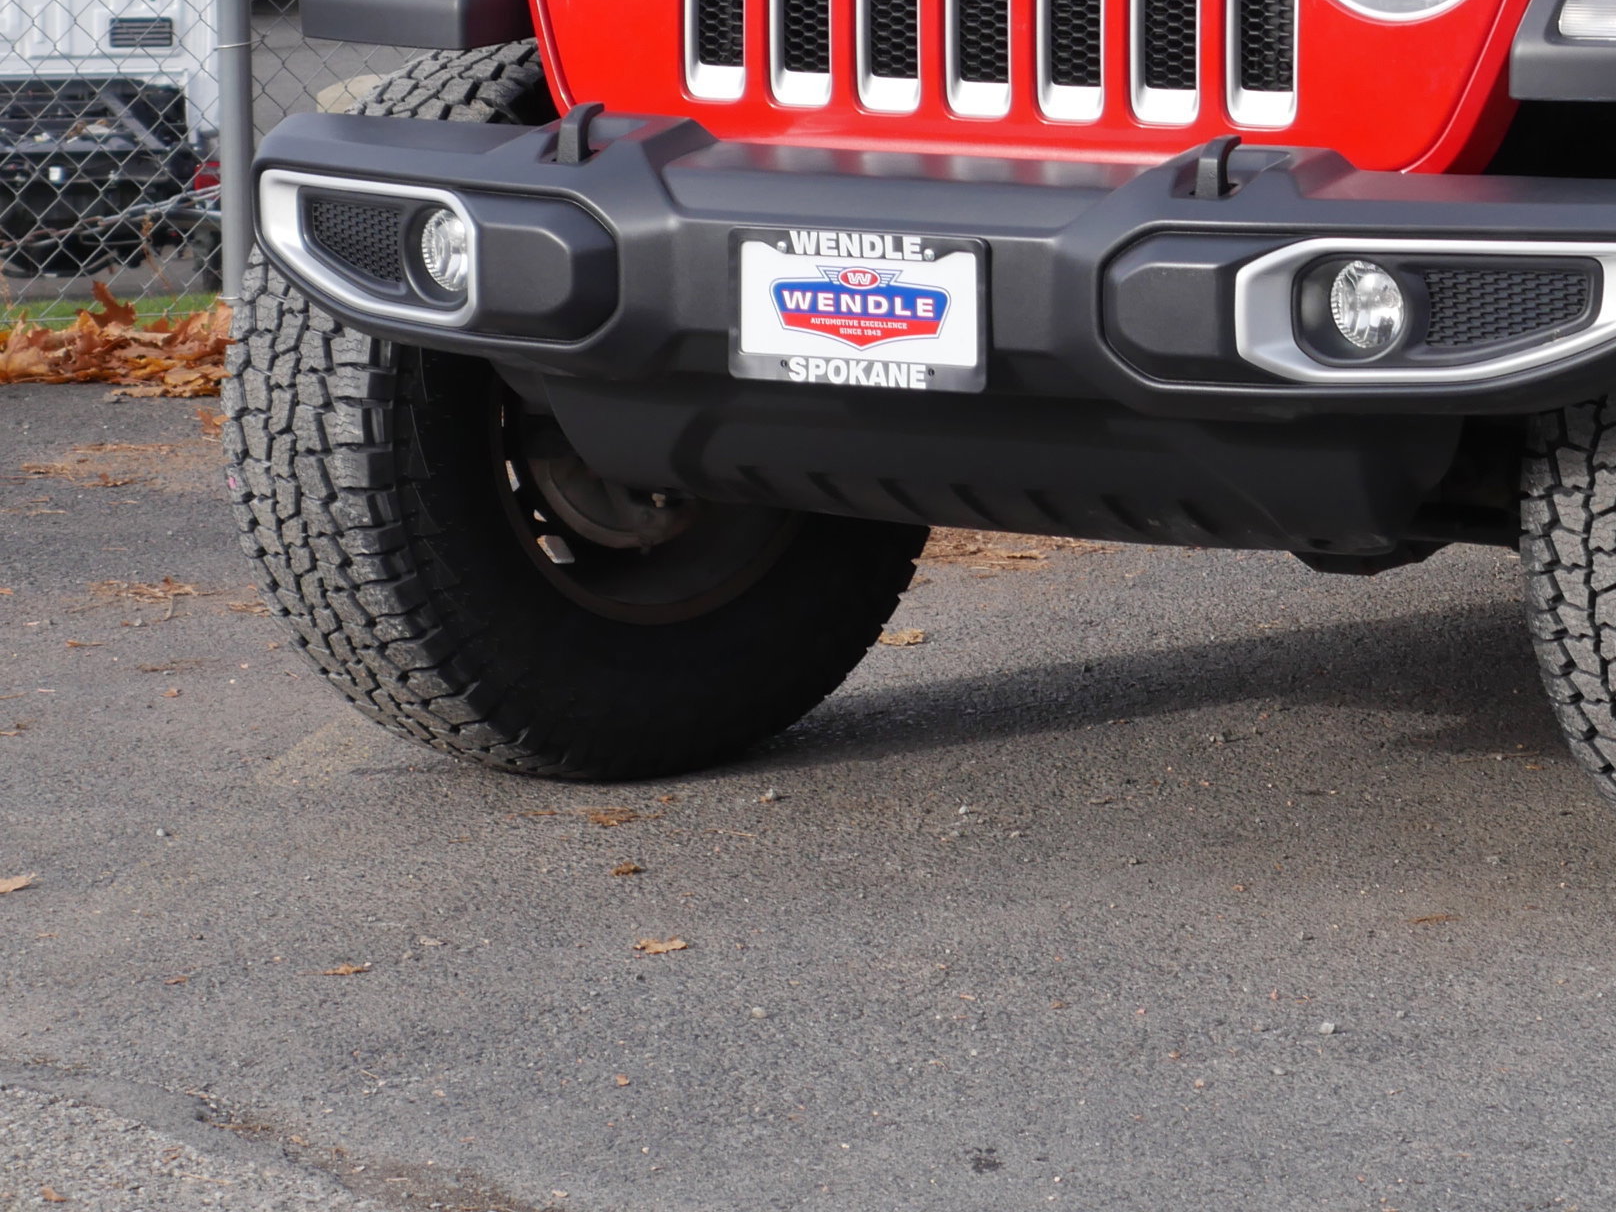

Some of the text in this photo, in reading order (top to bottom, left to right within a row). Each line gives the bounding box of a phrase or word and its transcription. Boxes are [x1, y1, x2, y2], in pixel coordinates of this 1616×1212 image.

[789, 230, 923, 261] WENDLE
[782, 290, 934, 318] WENDLE
[810, 317, 908, 329] AUTOMOTIVE EXCELLENCE
[839, 327, 862, 336] SINCE
[788, 357, 927, 389] SPOKANE
